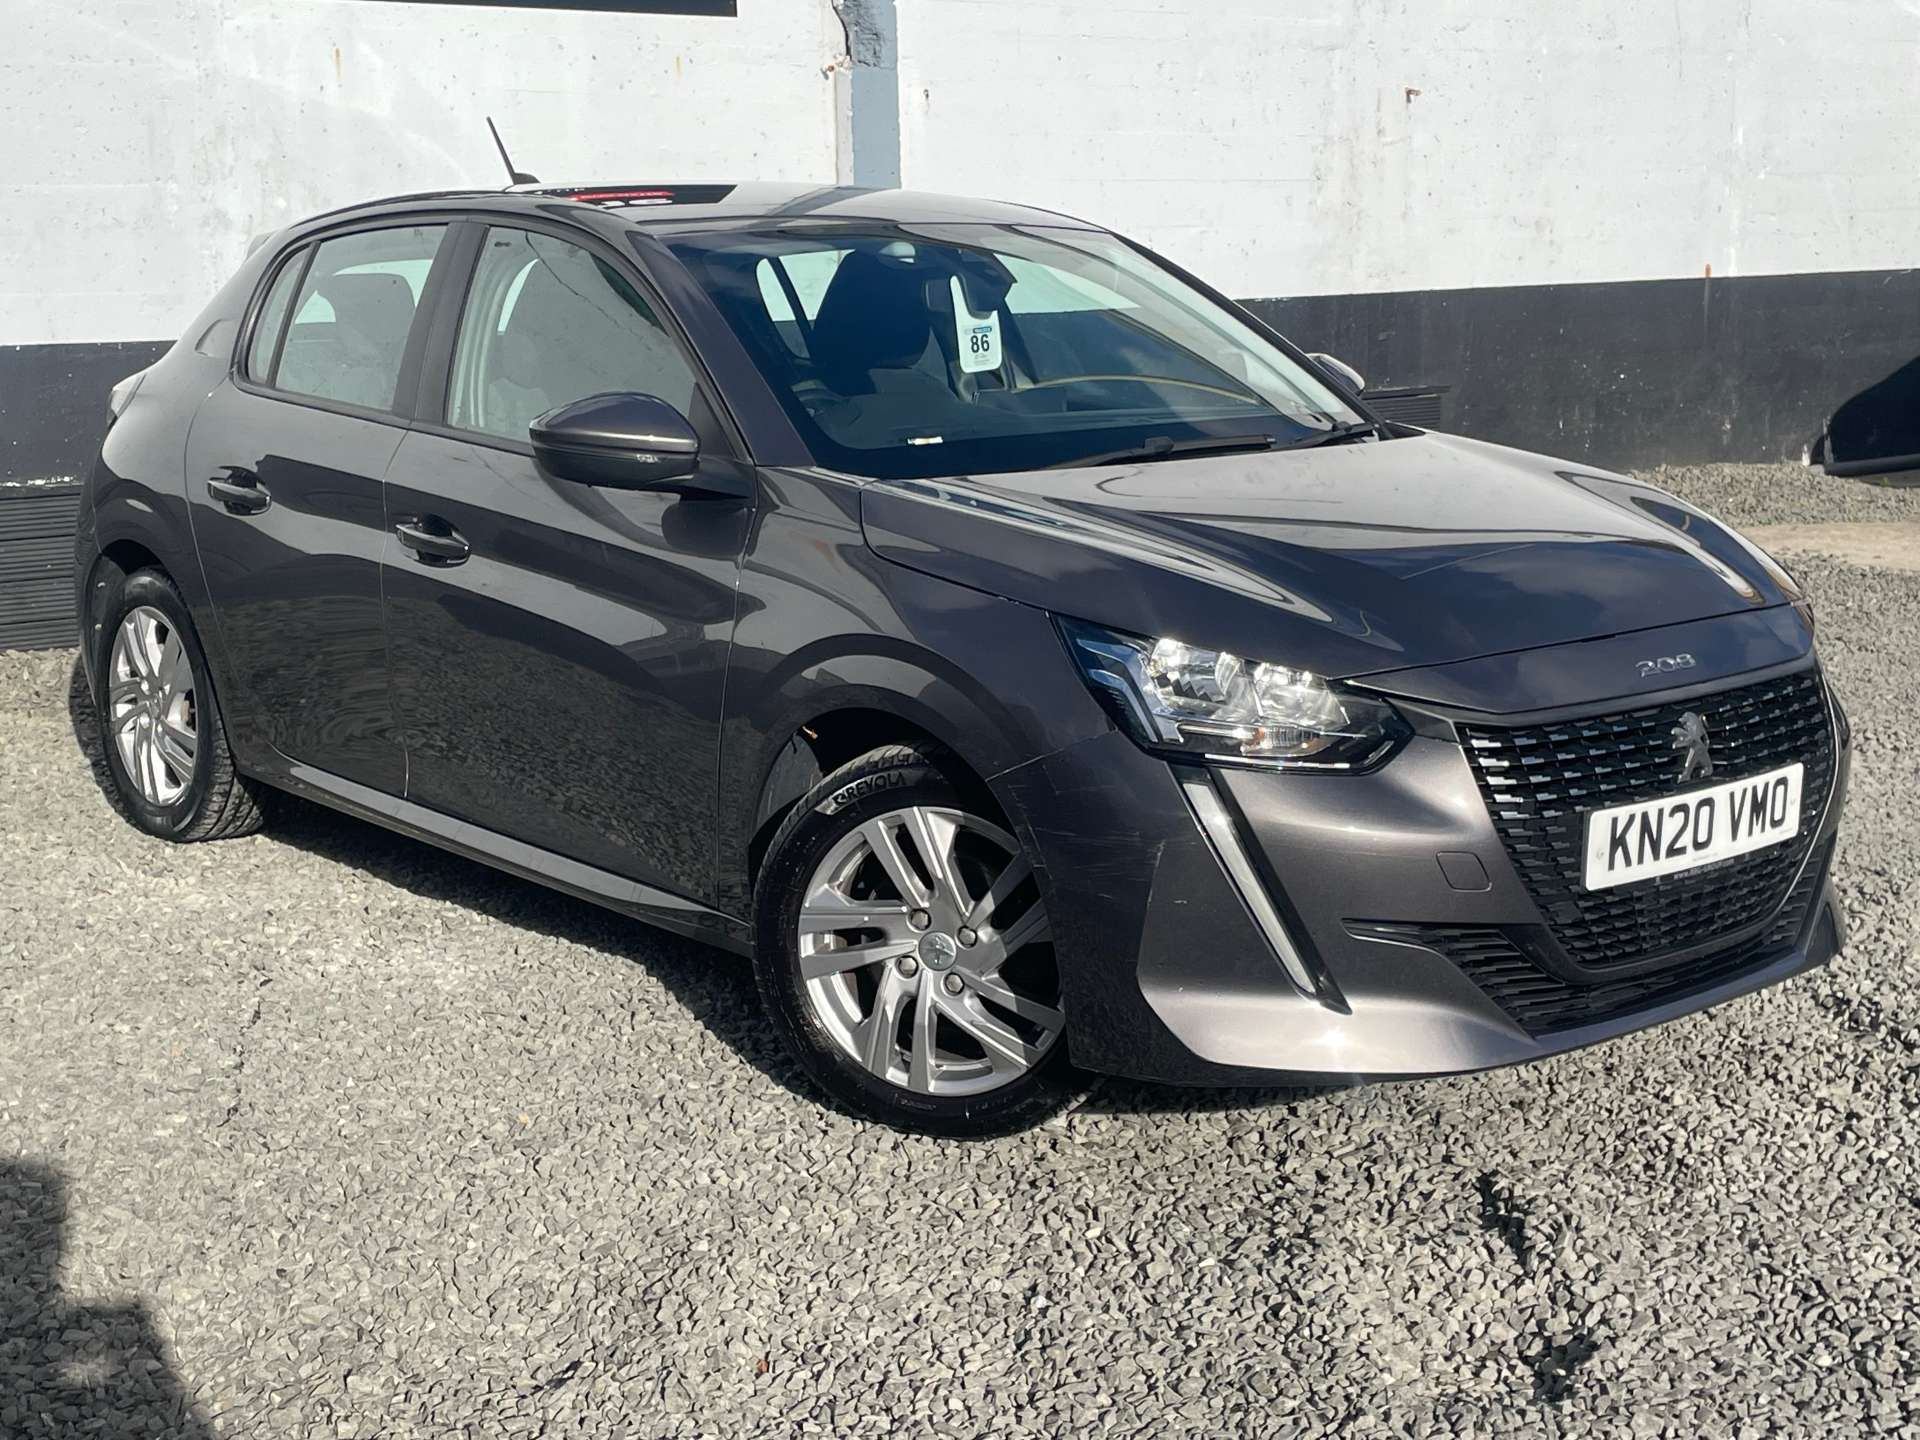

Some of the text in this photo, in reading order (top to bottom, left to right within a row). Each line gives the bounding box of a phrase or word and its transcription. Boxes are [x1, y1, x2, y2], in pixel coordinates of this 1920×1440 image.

[970, 334, 990, 354] 86
[1635, 653, 1696, 678] 208
[1607, 776, 1788, 872] KN20 VMO
